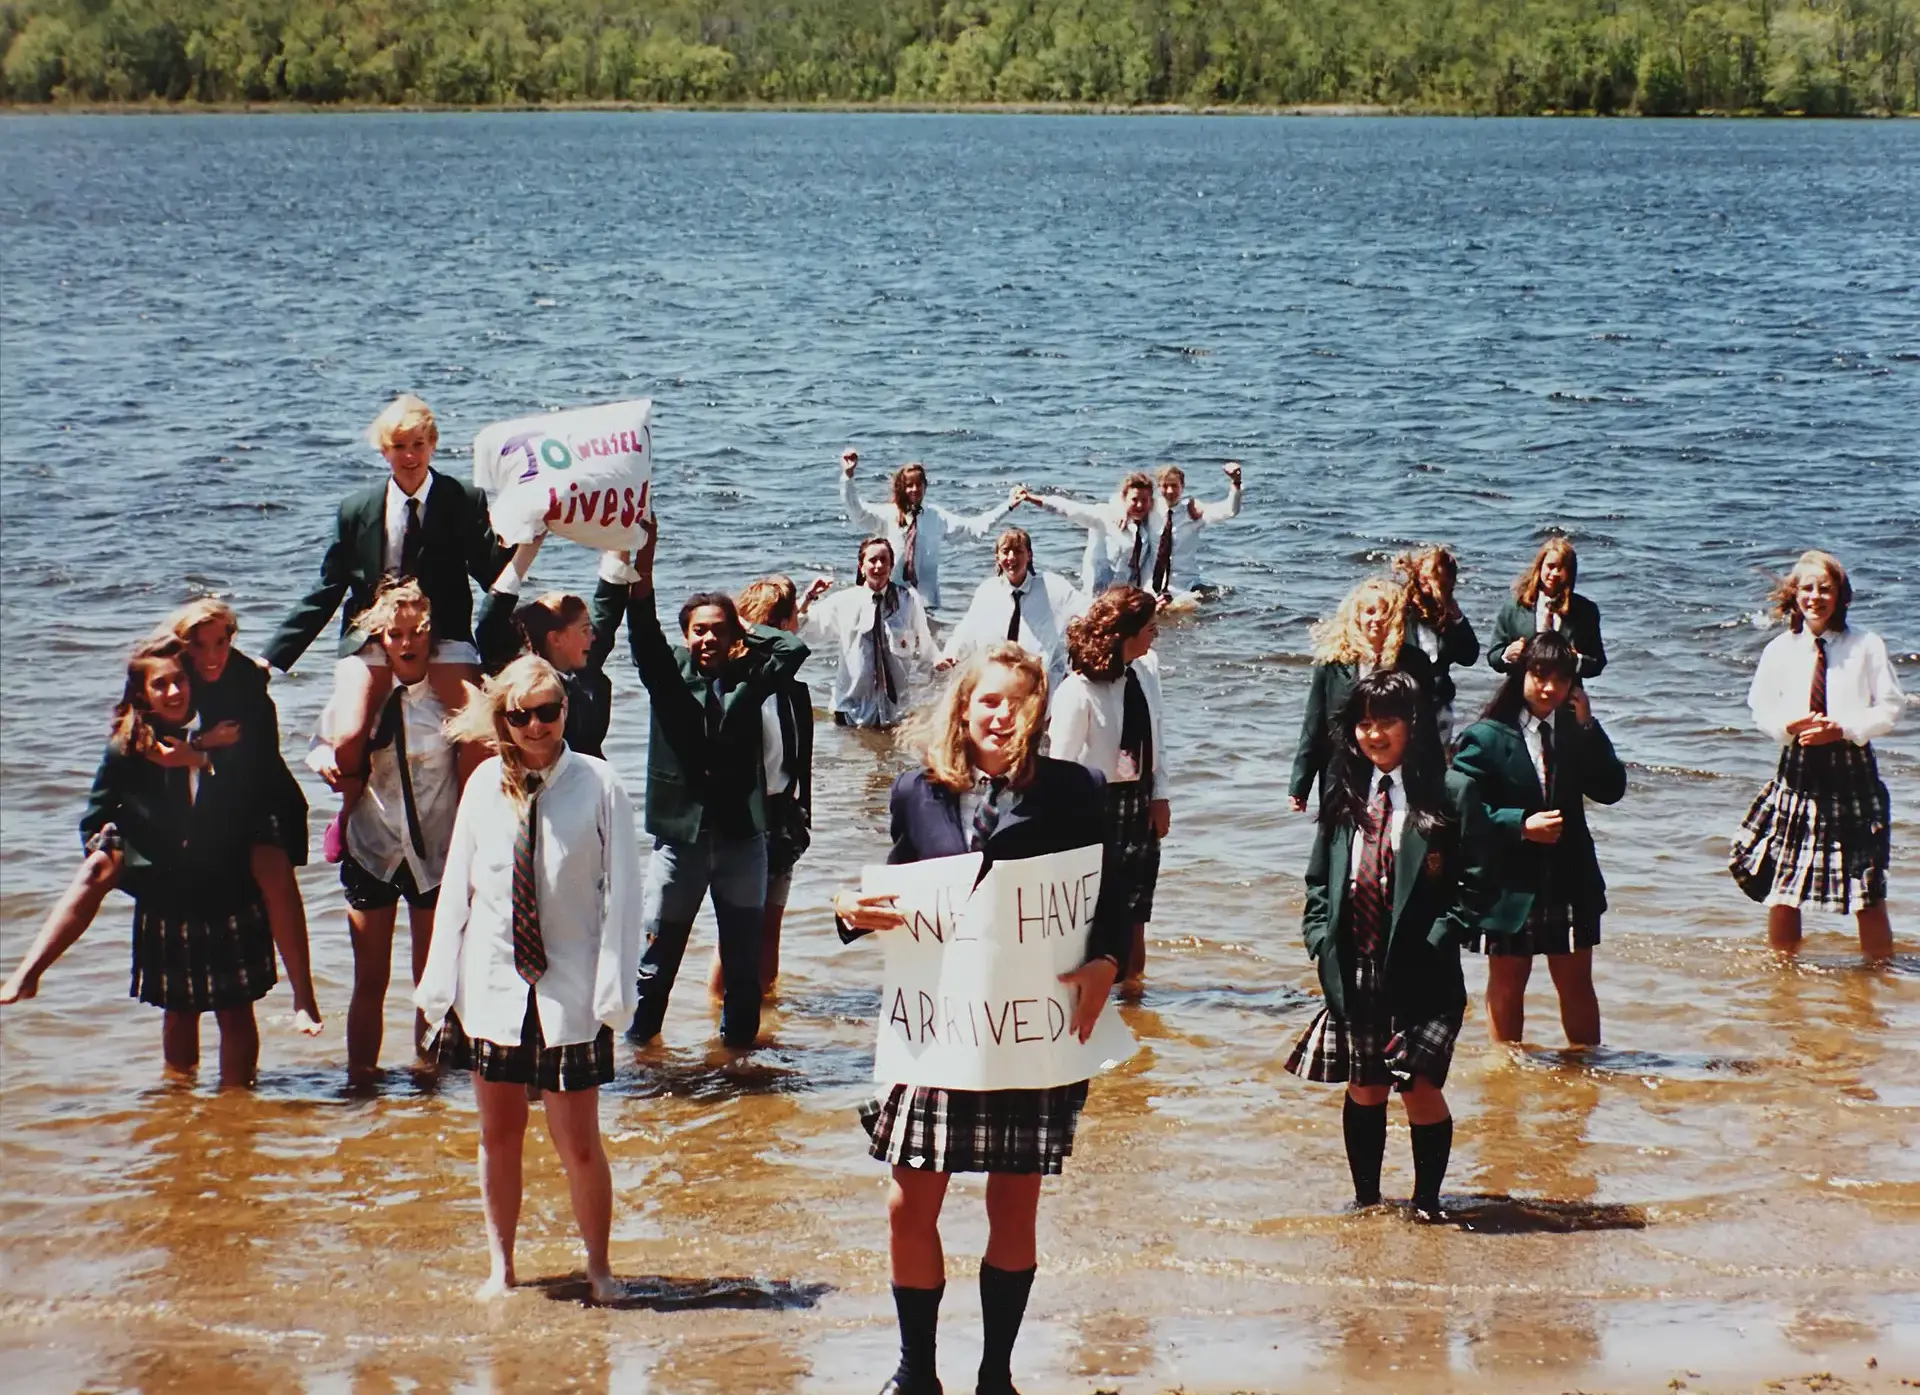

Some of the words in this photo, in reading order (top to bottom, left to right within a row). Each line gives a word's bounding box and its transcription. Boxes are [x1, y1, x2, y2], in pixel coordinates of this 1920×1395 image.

[890, 887, 978, 942] WE
[1018, 872, 1099, 943] HAVE
[890, 988, 1064, 1046] ARRIVED
